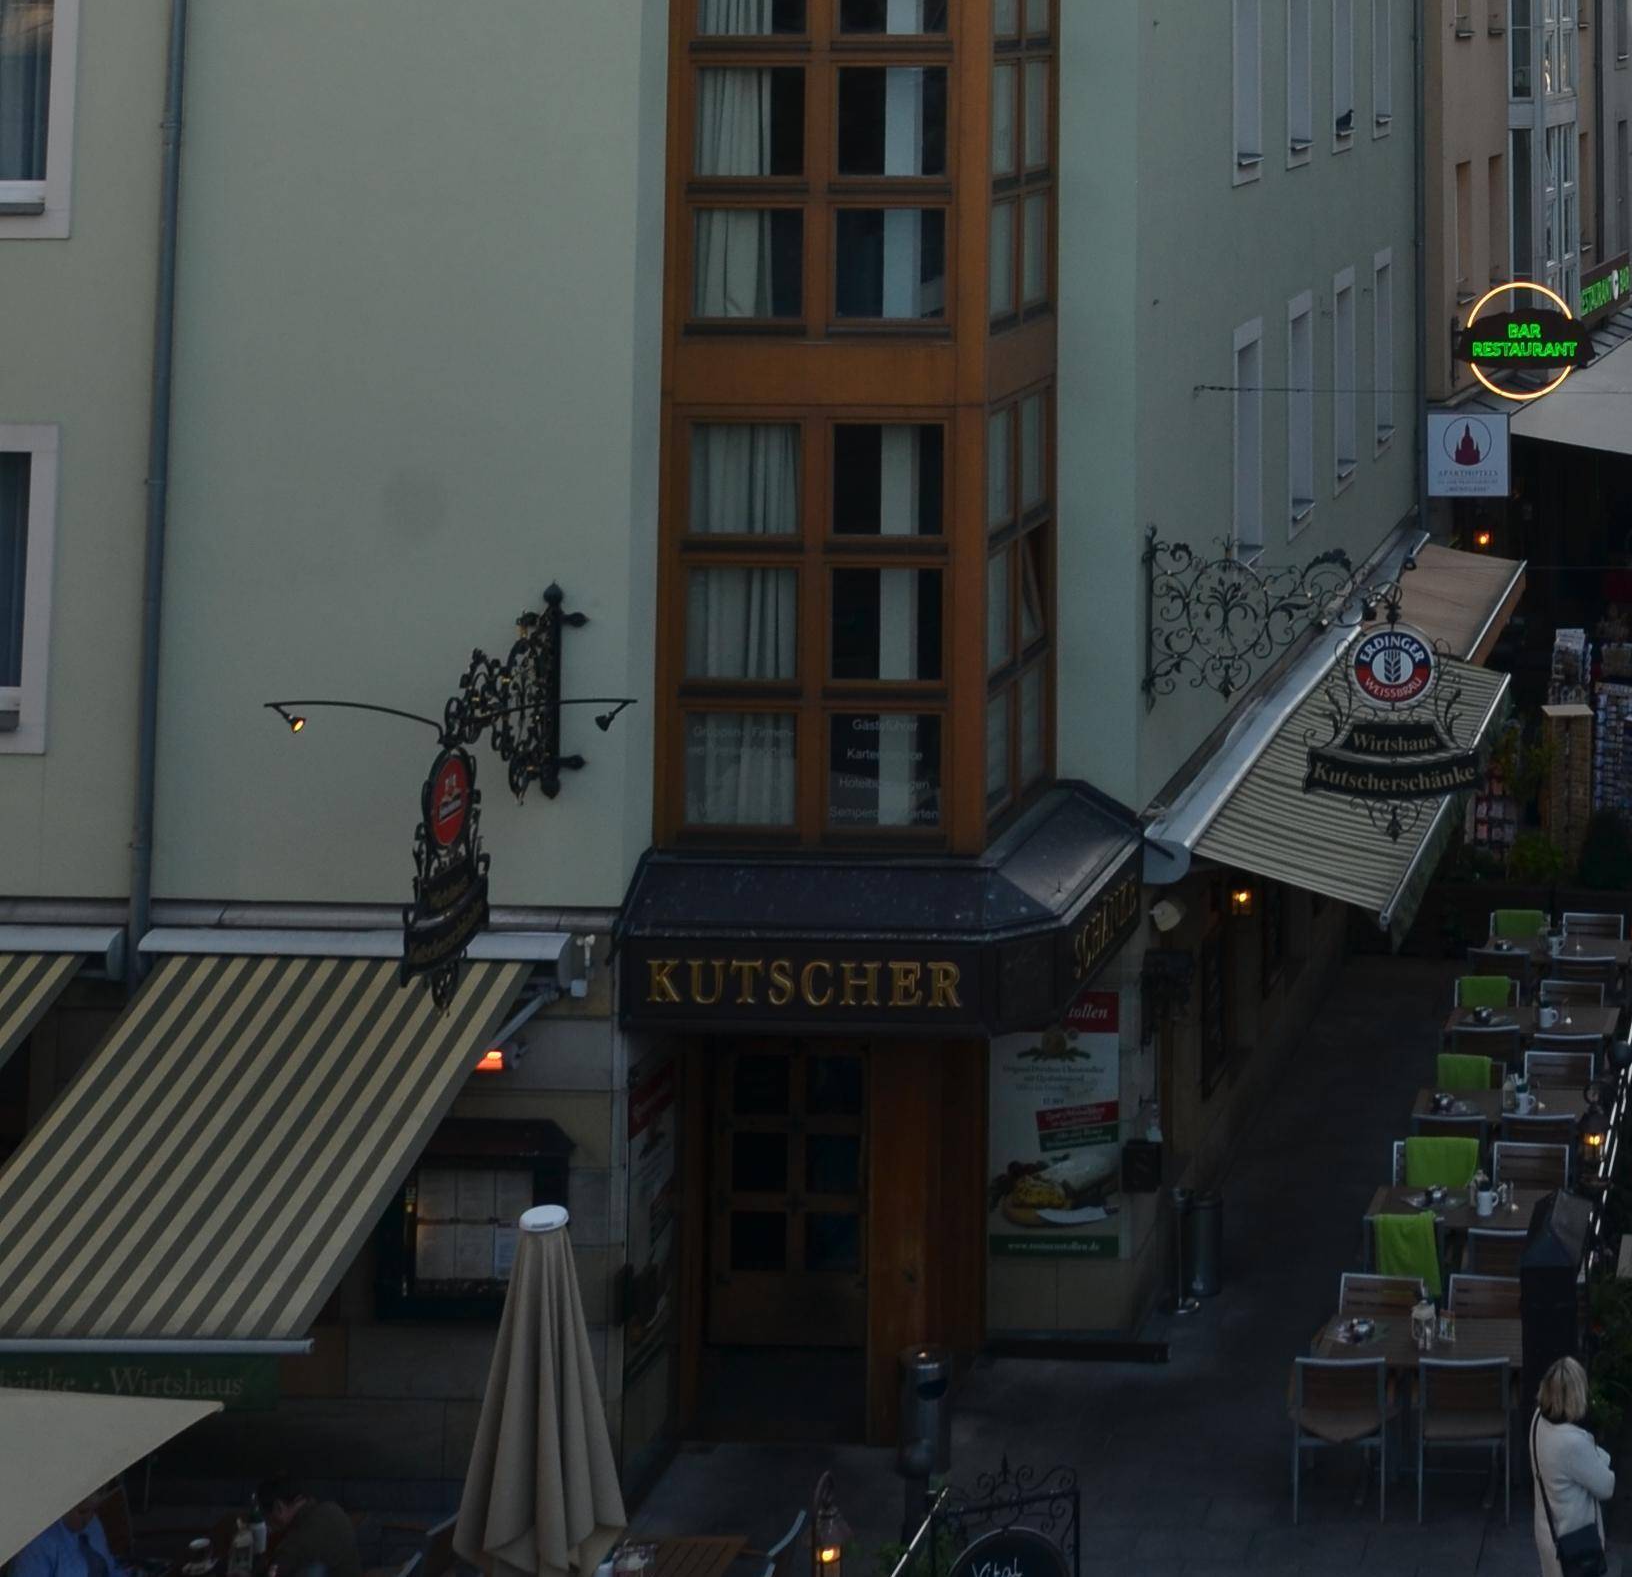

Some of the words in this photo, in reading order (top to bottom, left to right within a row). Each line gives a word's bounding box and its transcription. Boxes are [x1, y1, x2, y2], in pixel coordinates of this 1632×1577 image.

[1508, 323, 1542, 339] BAR
[1472, 341, 1578, 357] RESTAURANT
[1359, 635, 1425, 663] ERDINGER
[1351, 731, 1438, 752] Wirtshaus
[1312, 762, 1475, 792] Kutscherschänke
[645, 957, 963, 1009] KUTSCHER
